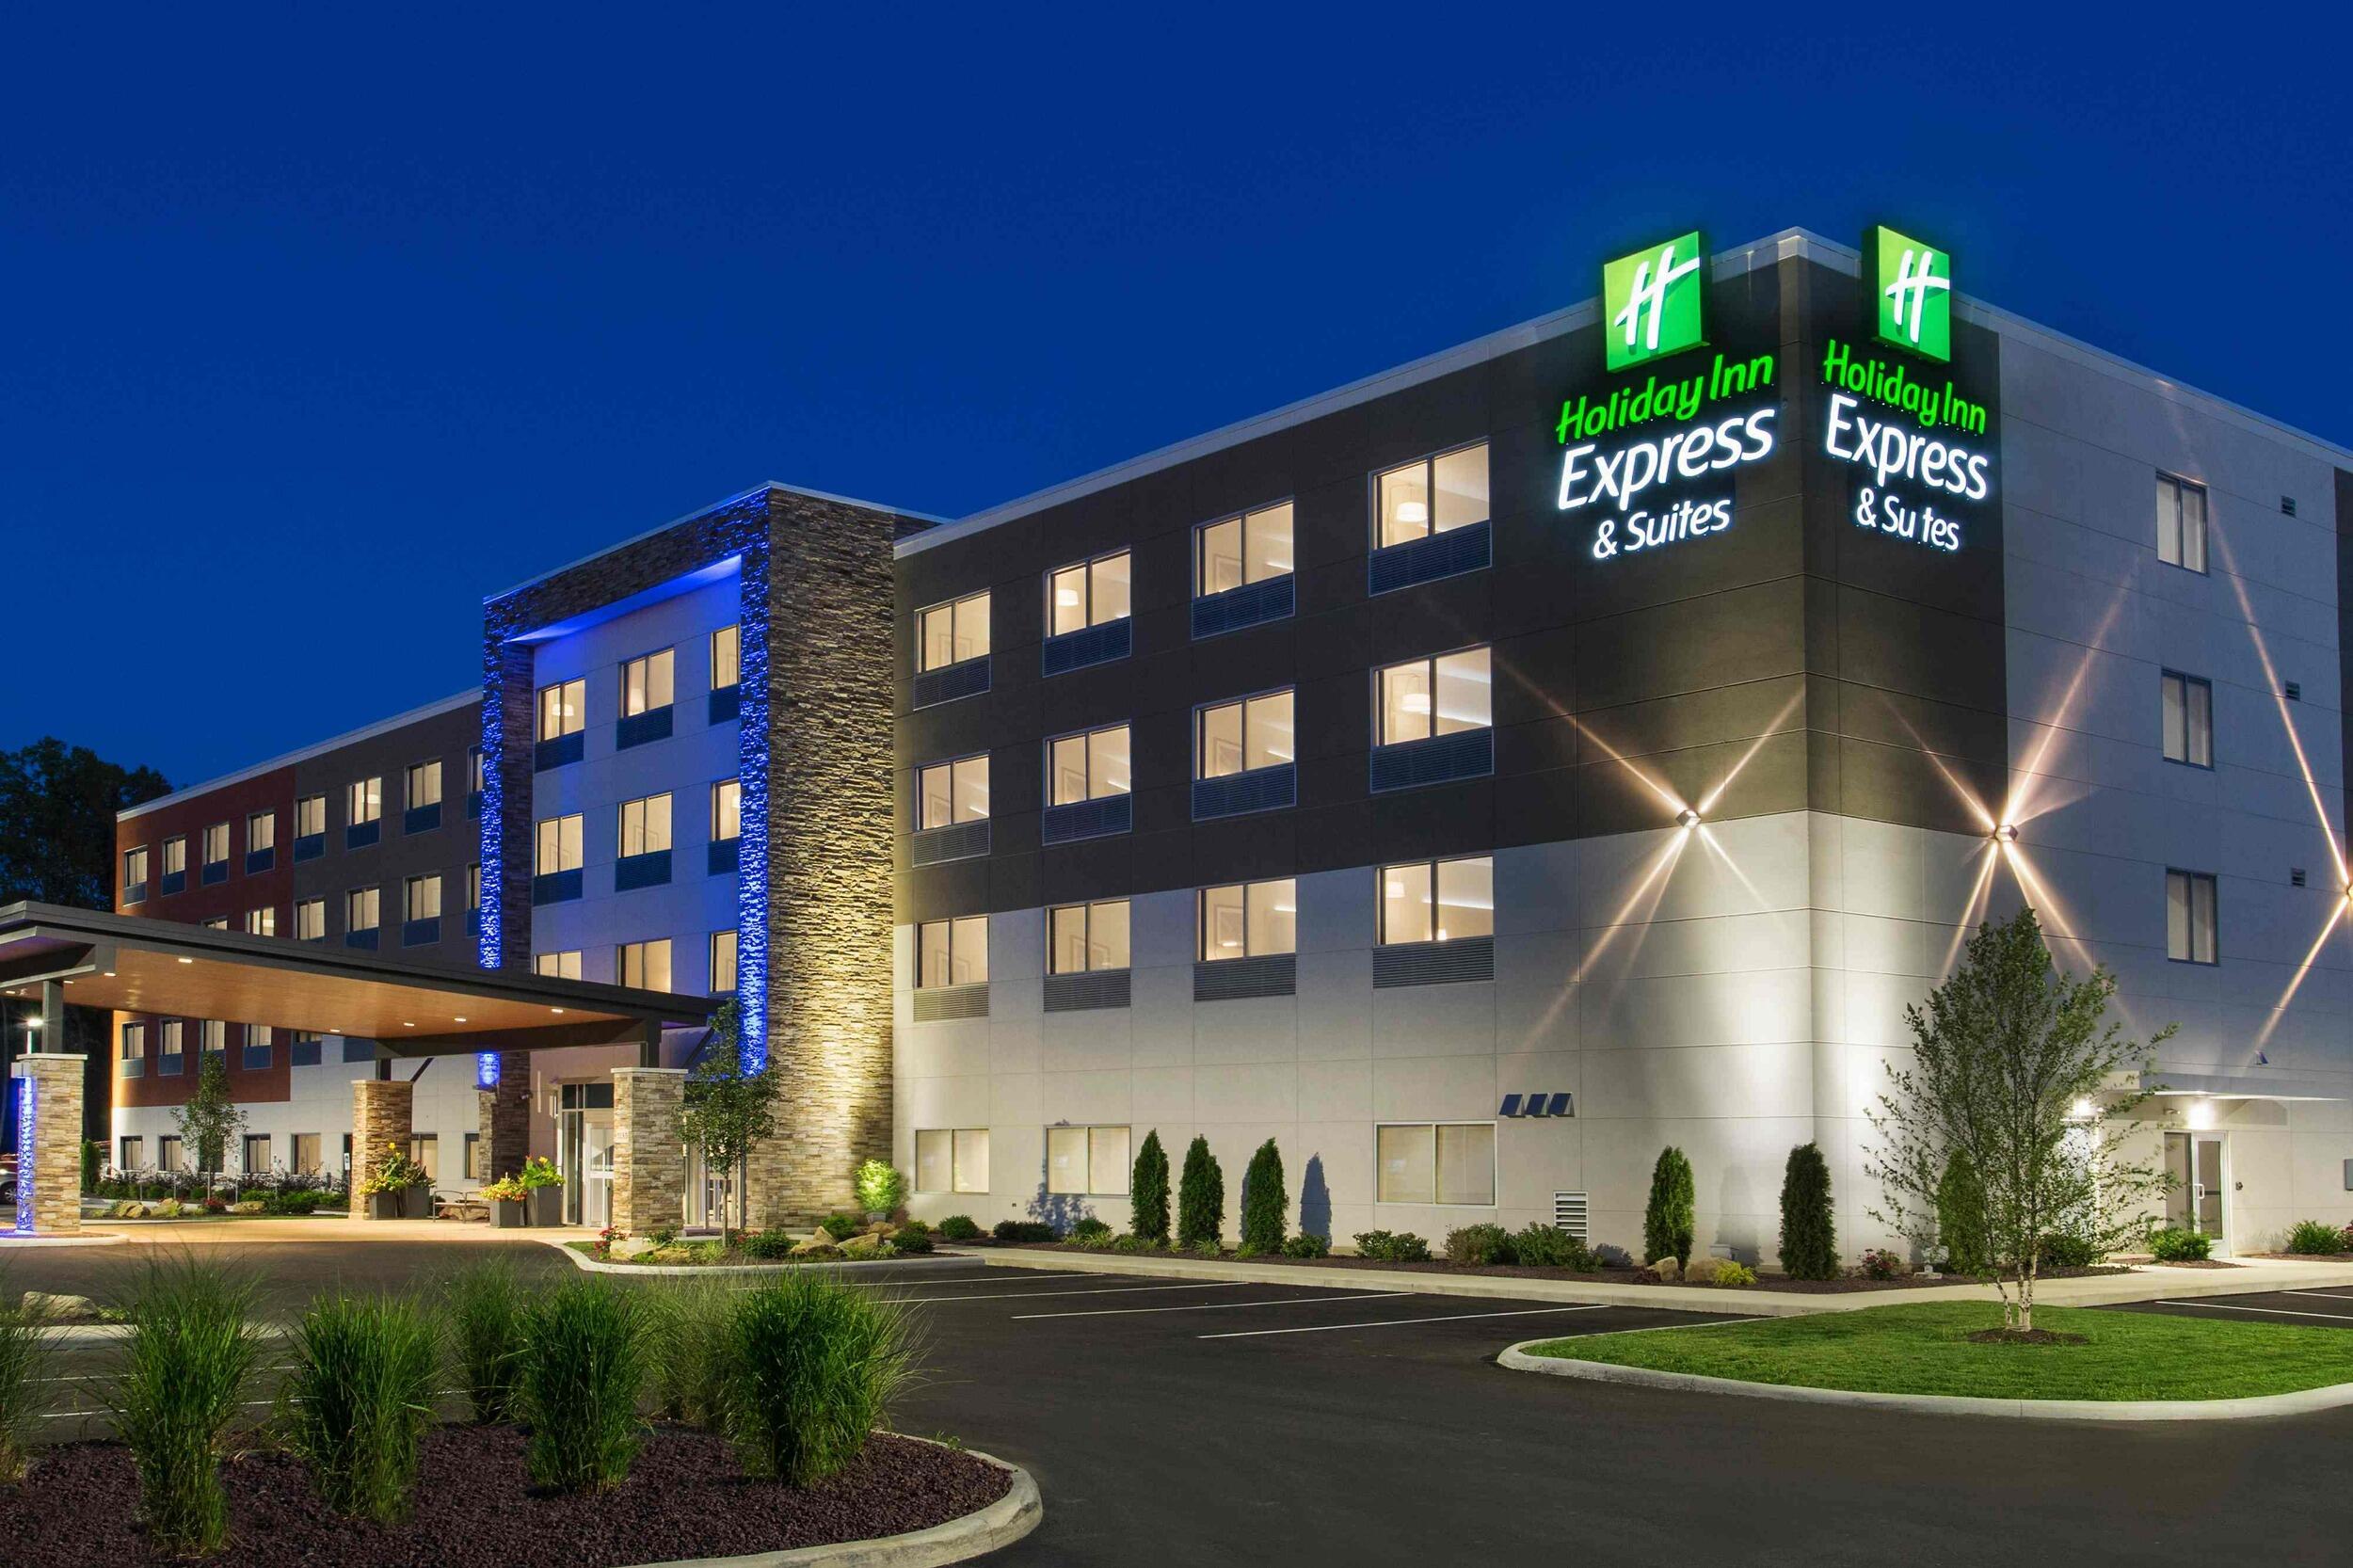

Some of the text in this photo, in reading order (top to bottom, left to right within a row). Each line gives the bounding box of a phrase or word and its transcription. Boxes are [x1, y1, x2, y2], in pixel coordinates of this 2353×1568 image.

[1613, 245, 1701, 351] H
[1884, 248, 1951, 344] H
[1555, 353, 1774, 445] Holiday Inn
[1822, 339, 1987, 435] Holiday Inn
[1557, 408, 1776, 512] Express
[1825, 392, 1988, 501] Express
[1593, 498, 1732, 560] & Suites
[1856, 487, 1961, 552] & Sutes
